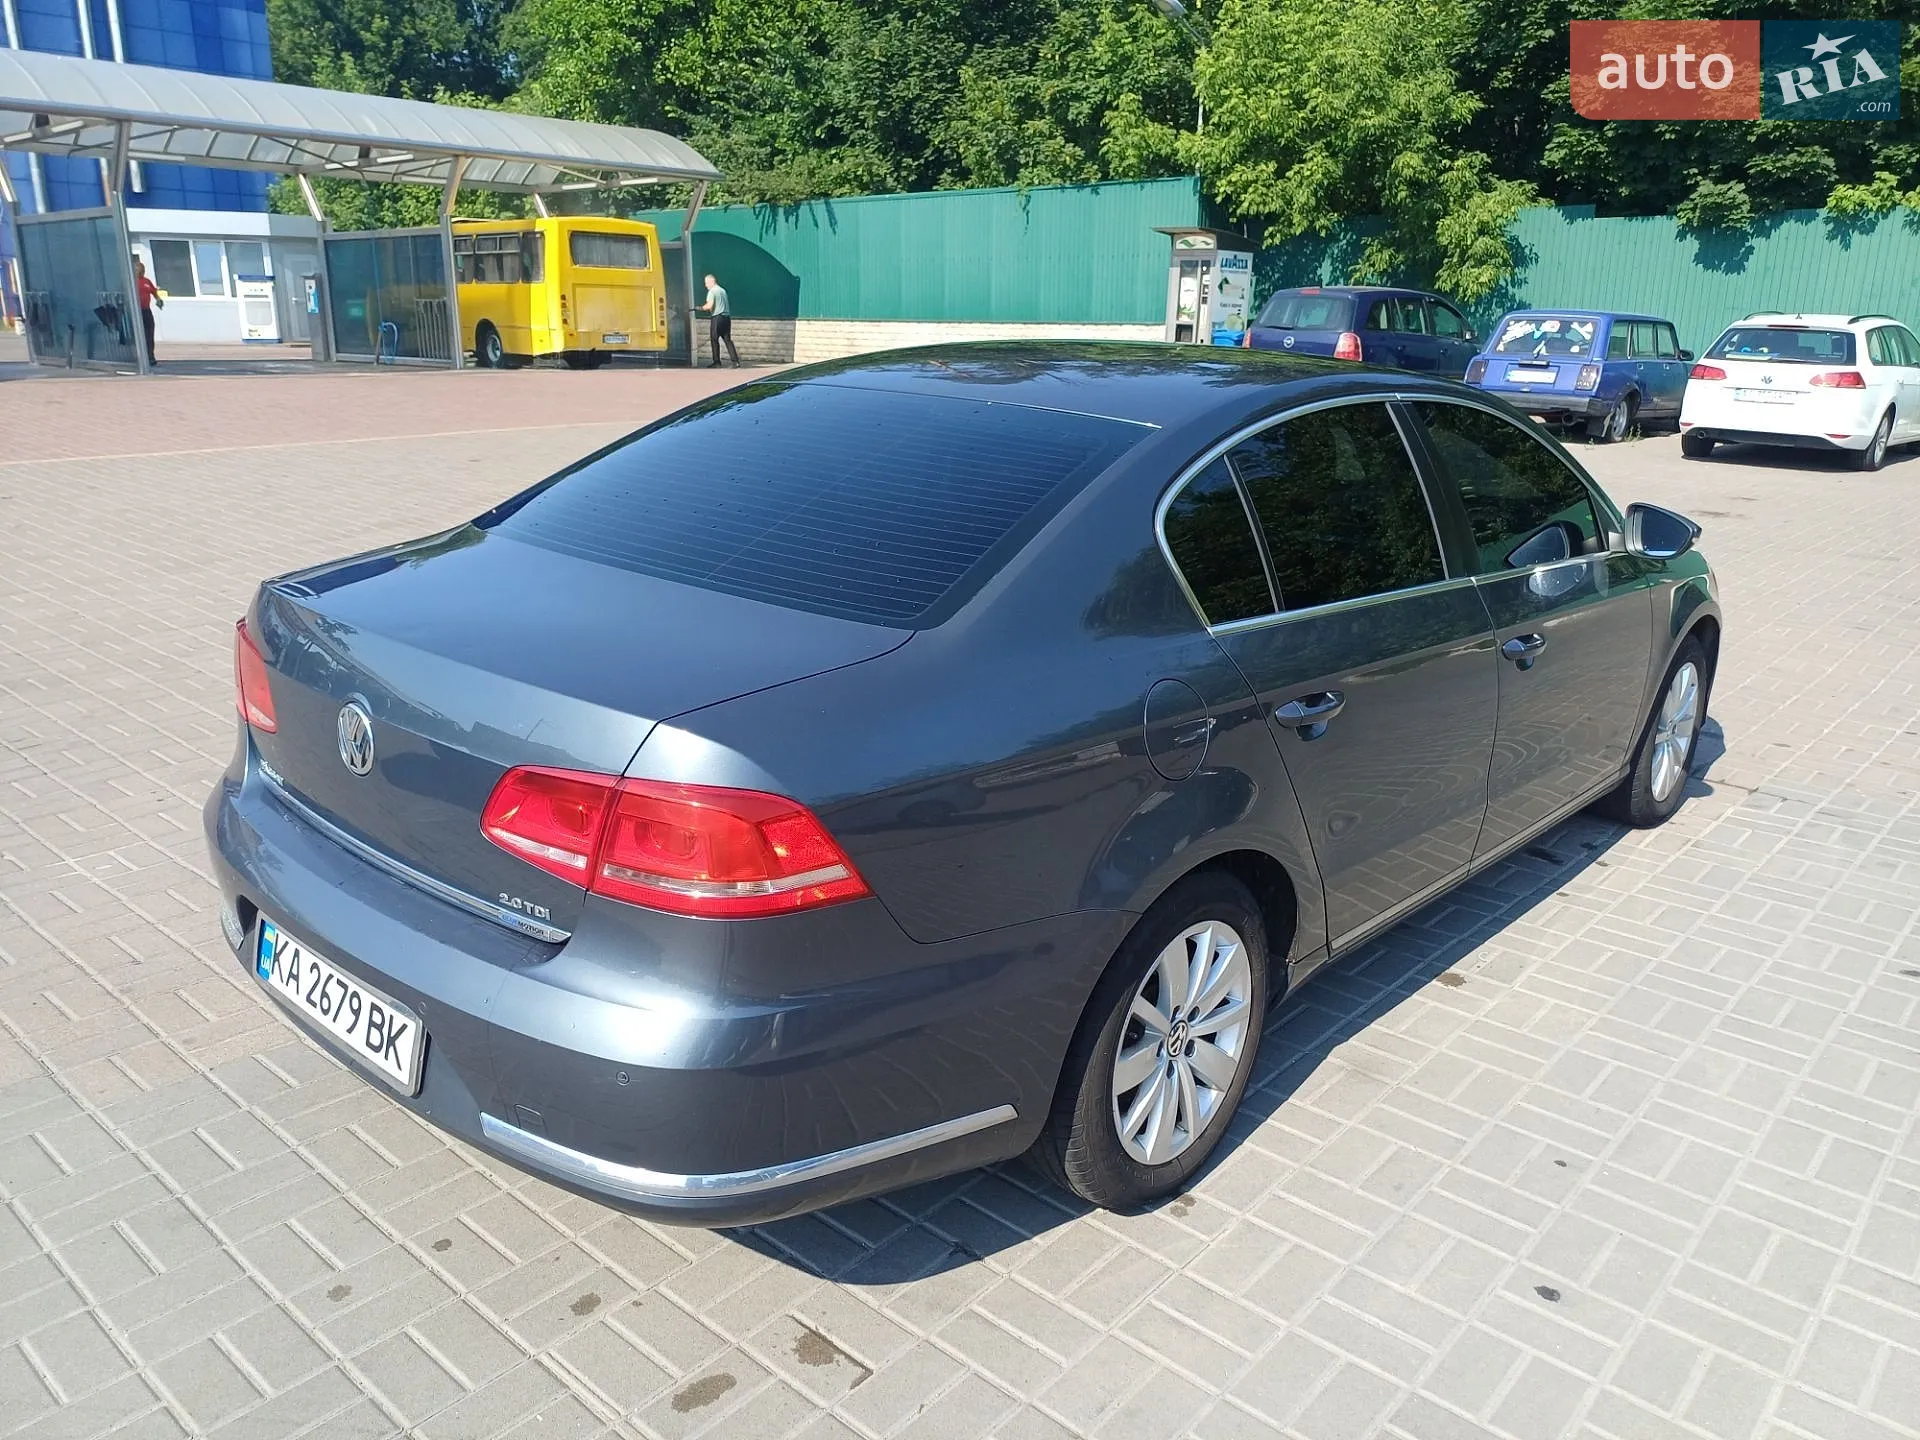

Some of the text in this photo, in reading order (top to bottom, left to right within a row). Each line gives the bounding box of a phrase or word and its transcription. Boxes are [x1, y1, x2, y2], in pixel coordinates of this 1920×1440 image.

[498, 892, 522, 909] 2.0
[260, 955, 271, 971] UA
[271, 932, 408, 1072] KA 2679 BK
